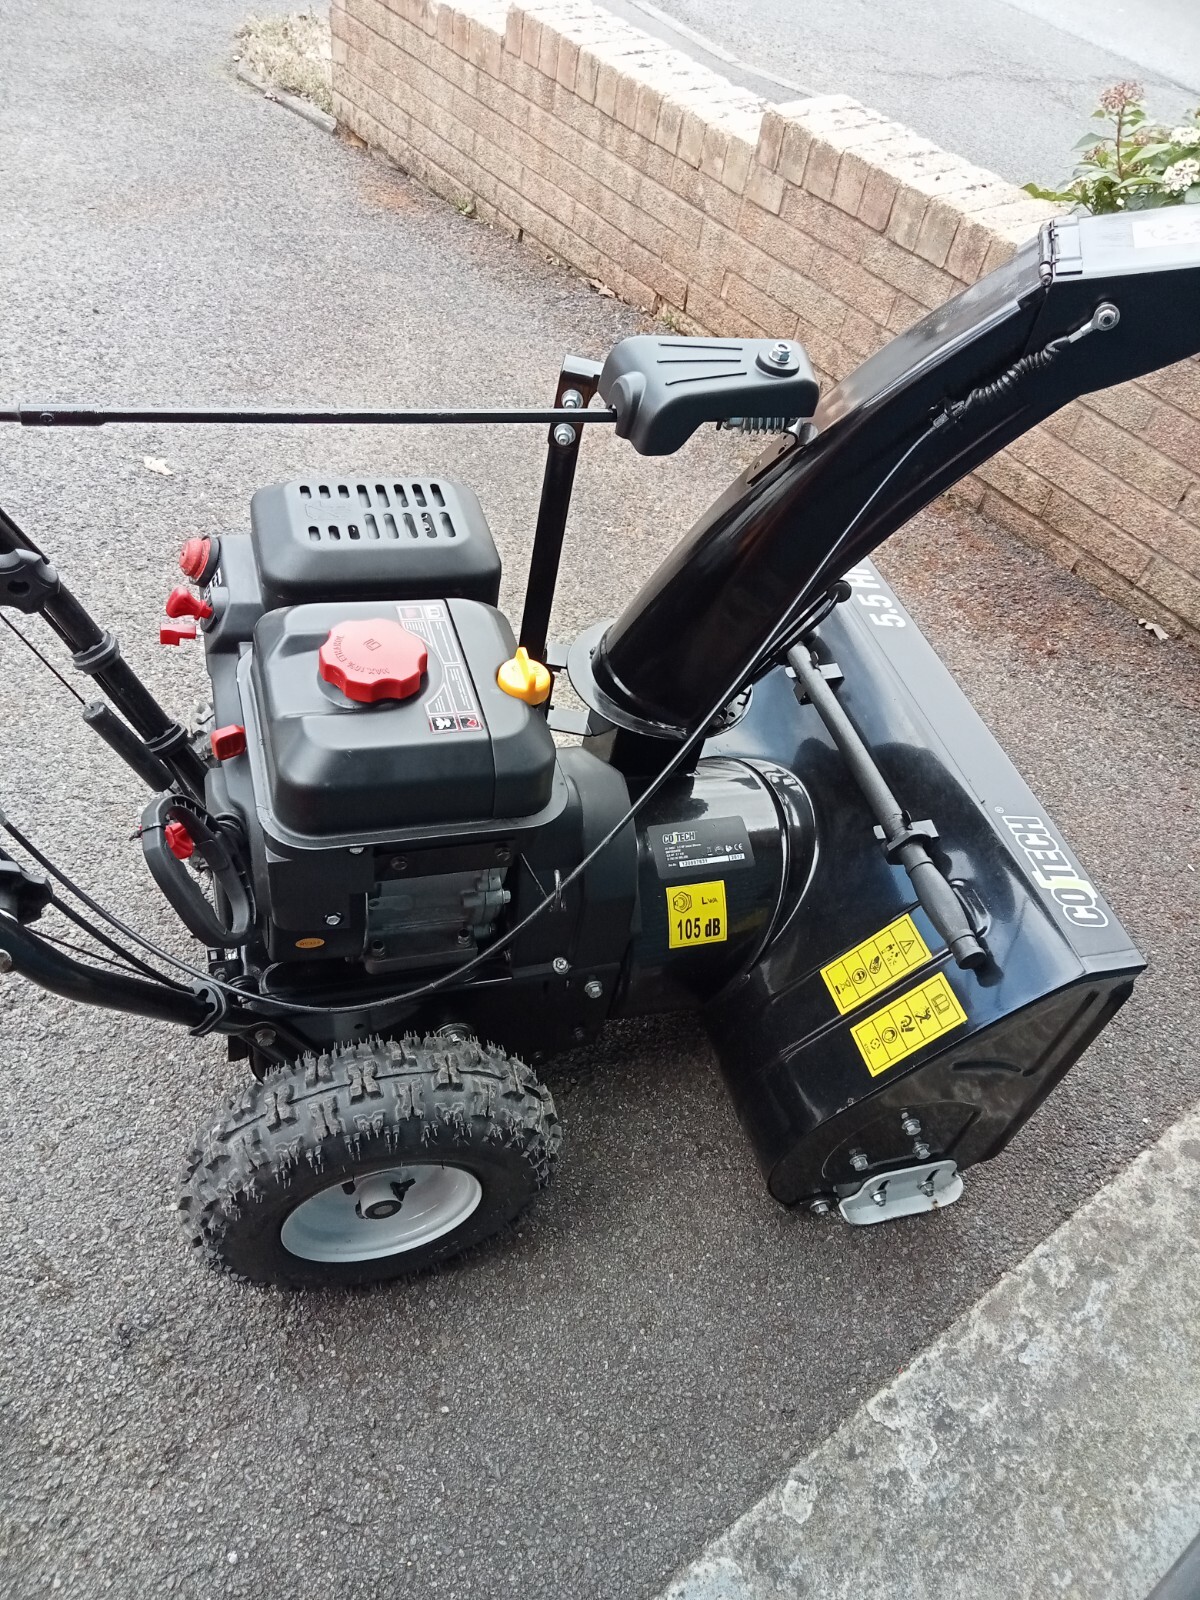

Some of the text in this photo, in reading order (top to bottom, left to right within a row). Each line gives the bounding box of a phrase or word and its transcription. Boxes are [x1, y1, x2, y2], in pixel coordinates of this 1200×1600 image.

[857, 594, 906, 628] 5.5
[677, 918, 720, 940] 105 dB
